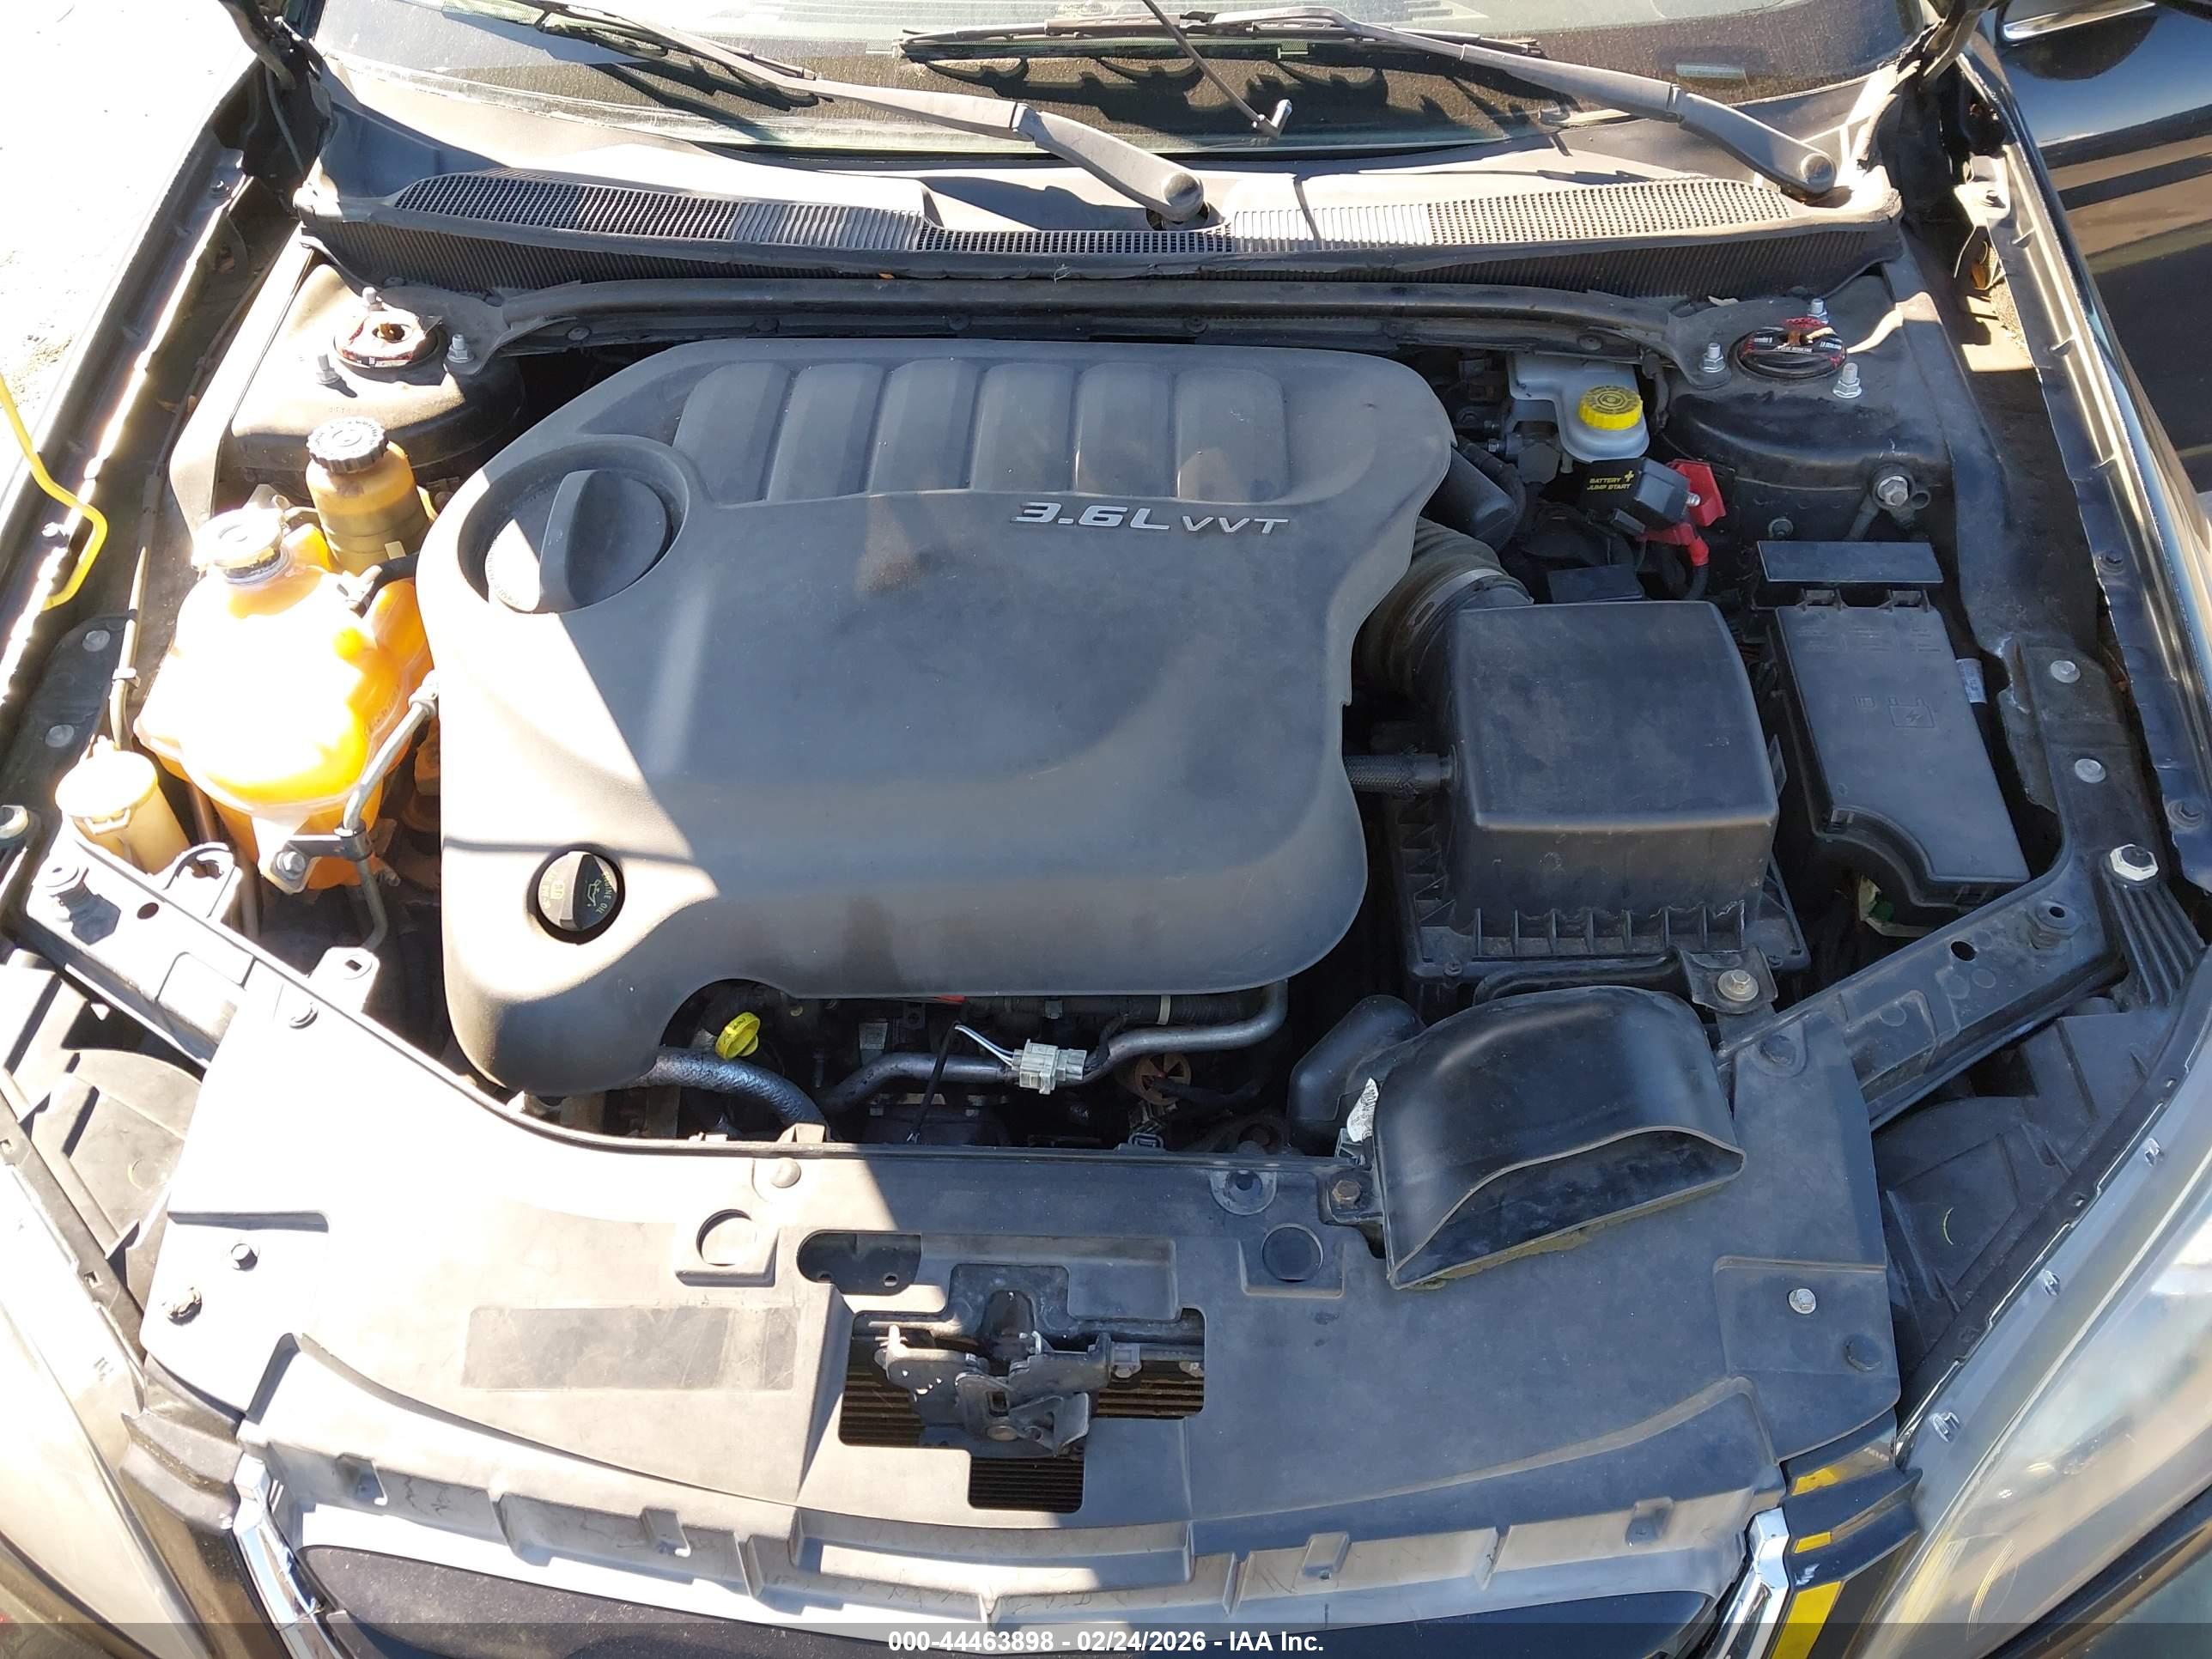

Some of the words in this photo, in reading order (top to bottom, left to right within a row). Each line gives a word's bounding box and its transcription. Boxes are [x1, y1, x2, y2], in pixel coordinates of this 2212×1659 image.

[1011, 501, 1170, 530] 3.6L
[1182, 515, 1289, 534] VVT
[596, 902, 608, 914] OIL
